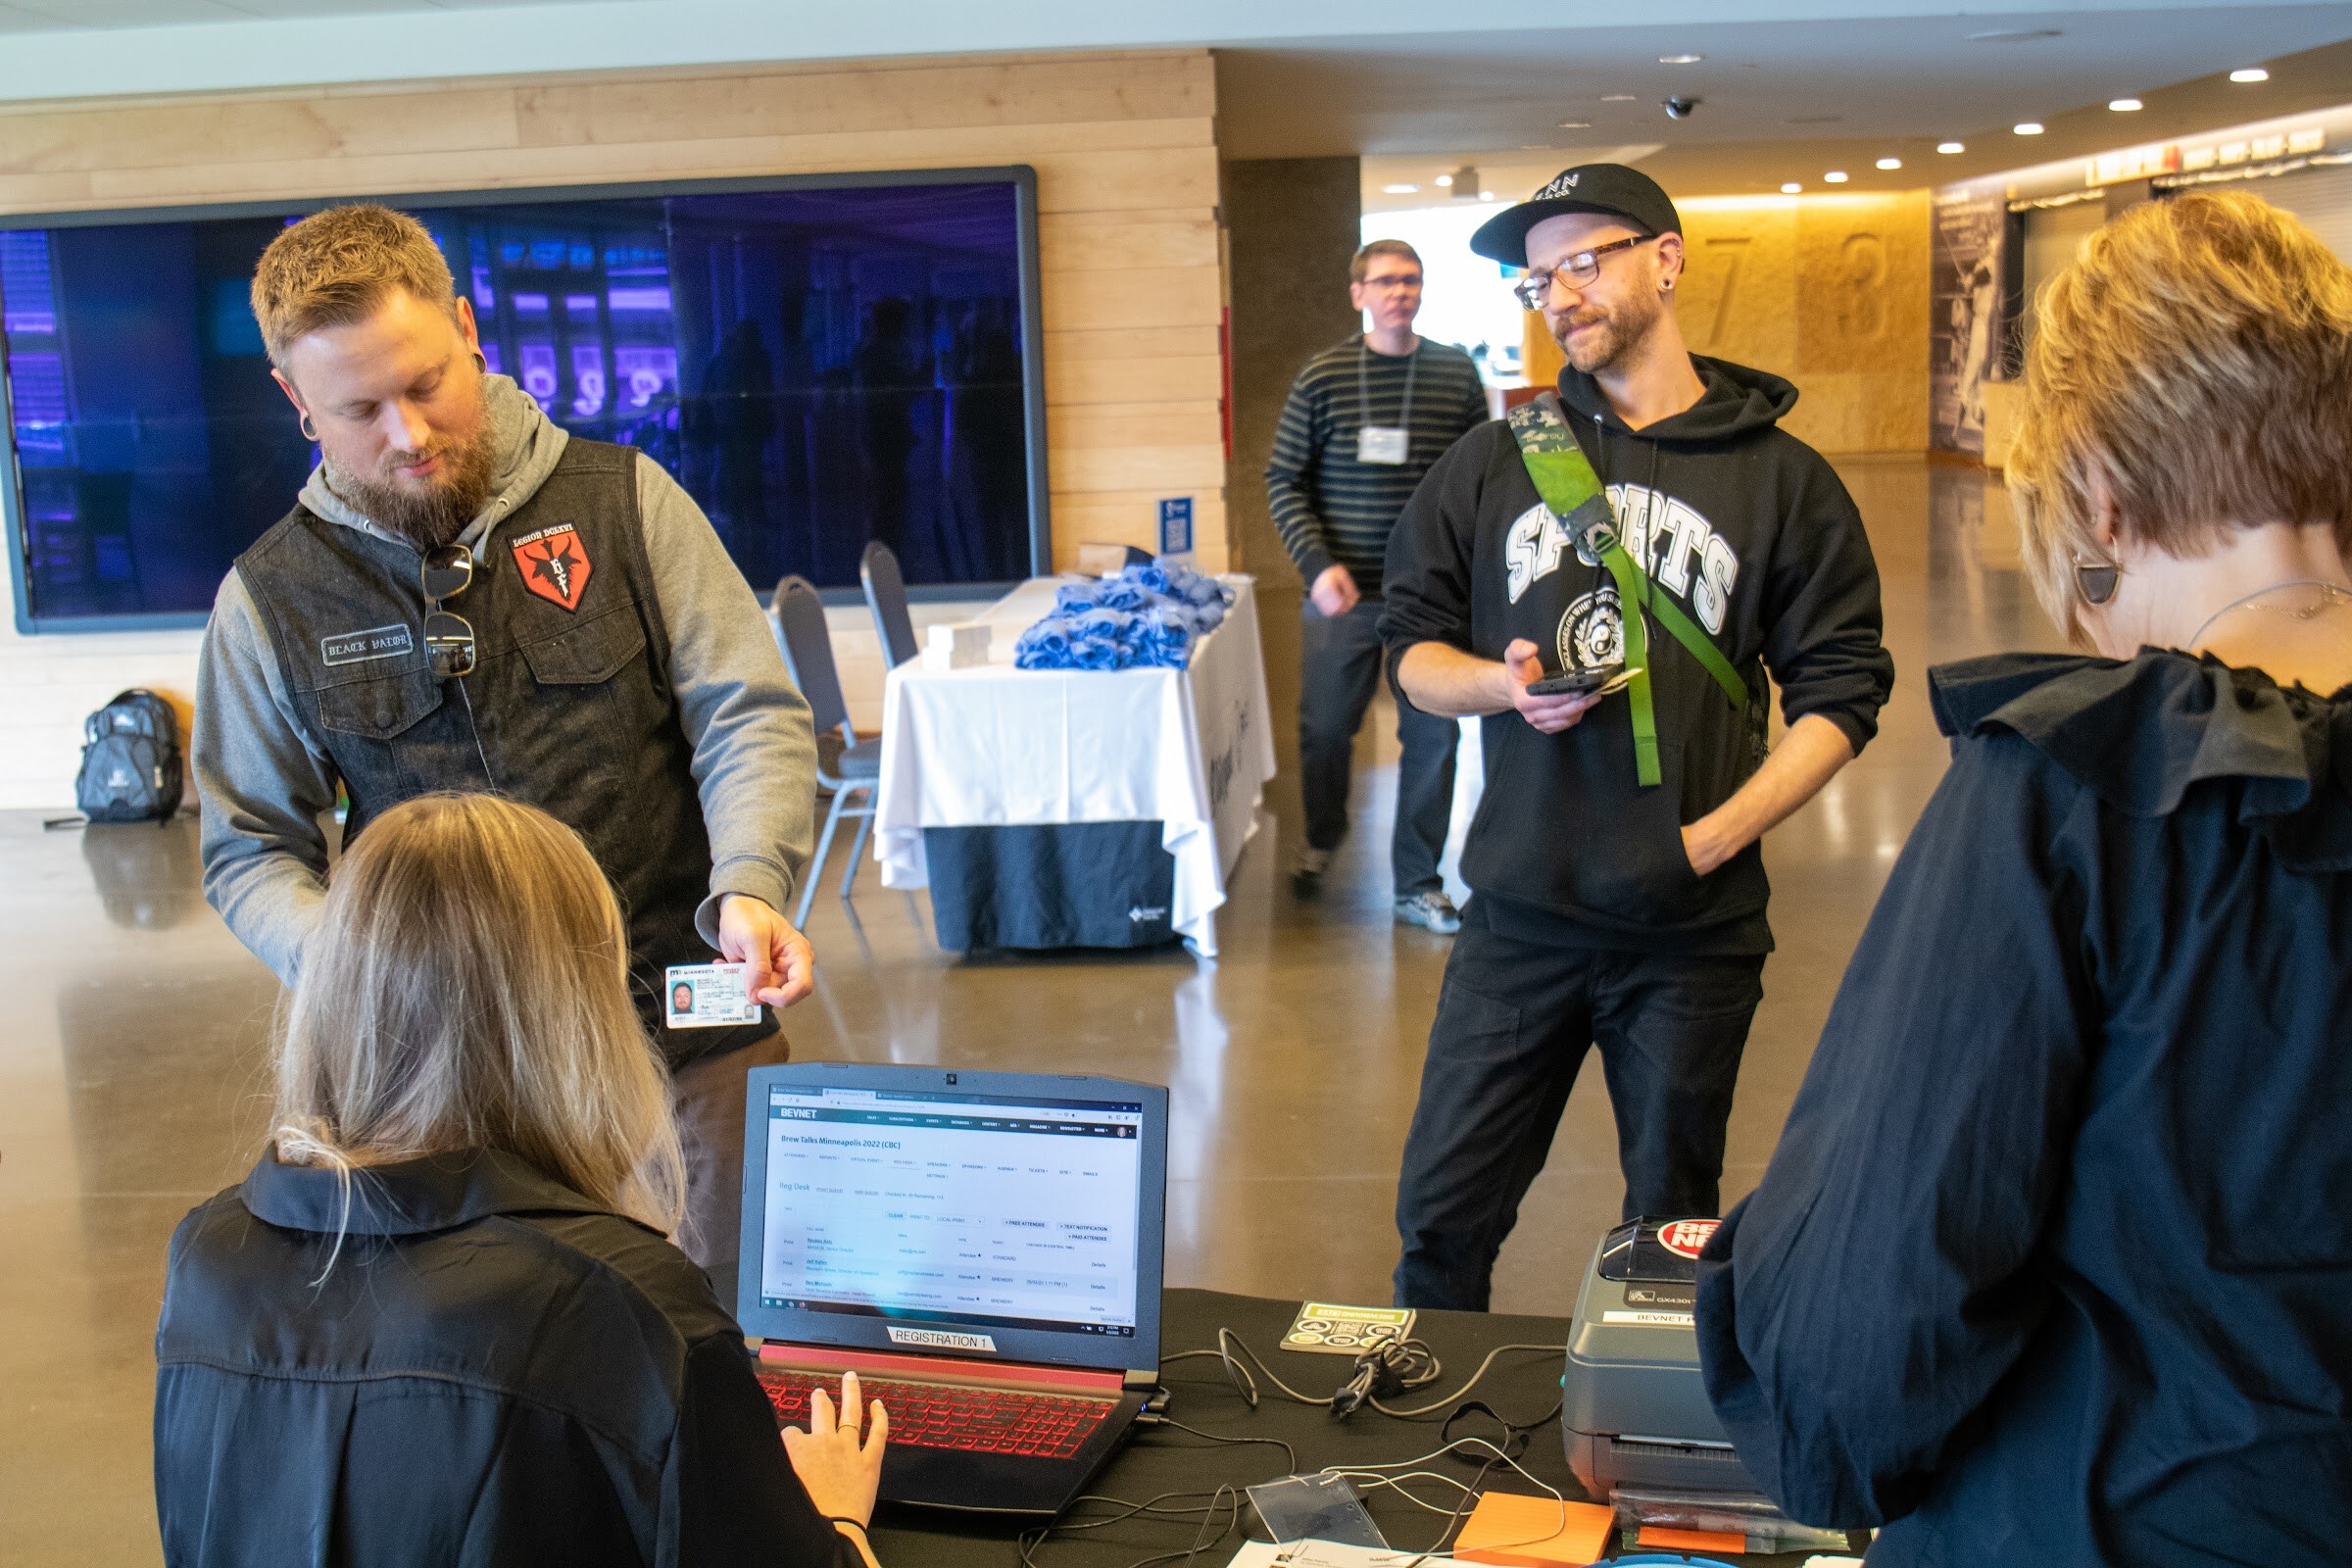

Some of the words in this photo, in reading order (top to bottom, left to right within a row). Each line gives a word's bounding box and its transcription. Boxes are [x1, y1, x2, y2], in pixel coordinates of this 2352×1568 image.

[328, 640, 368, 657] BLACK
[780, 1107, 817, 1119] BEVNET
[781, 1135, 800, 1144] Brew
[801, 1136, 817, 1145] Talks
[818, 1137, 861, 1148] Minneapolis
[881, 1141, 901, 1151] (CBC)
[779, 1182, 793, 1192] Reg
[1674, 1222, 1718, 1235] BE
[1670, 1233, 1709, 1249] NE
[1638, 1314, 1682, 1323] BEVNET
[896, 1330, 978, 1347] REGISTRATION
[981, 1338, 986, 1348] 1
